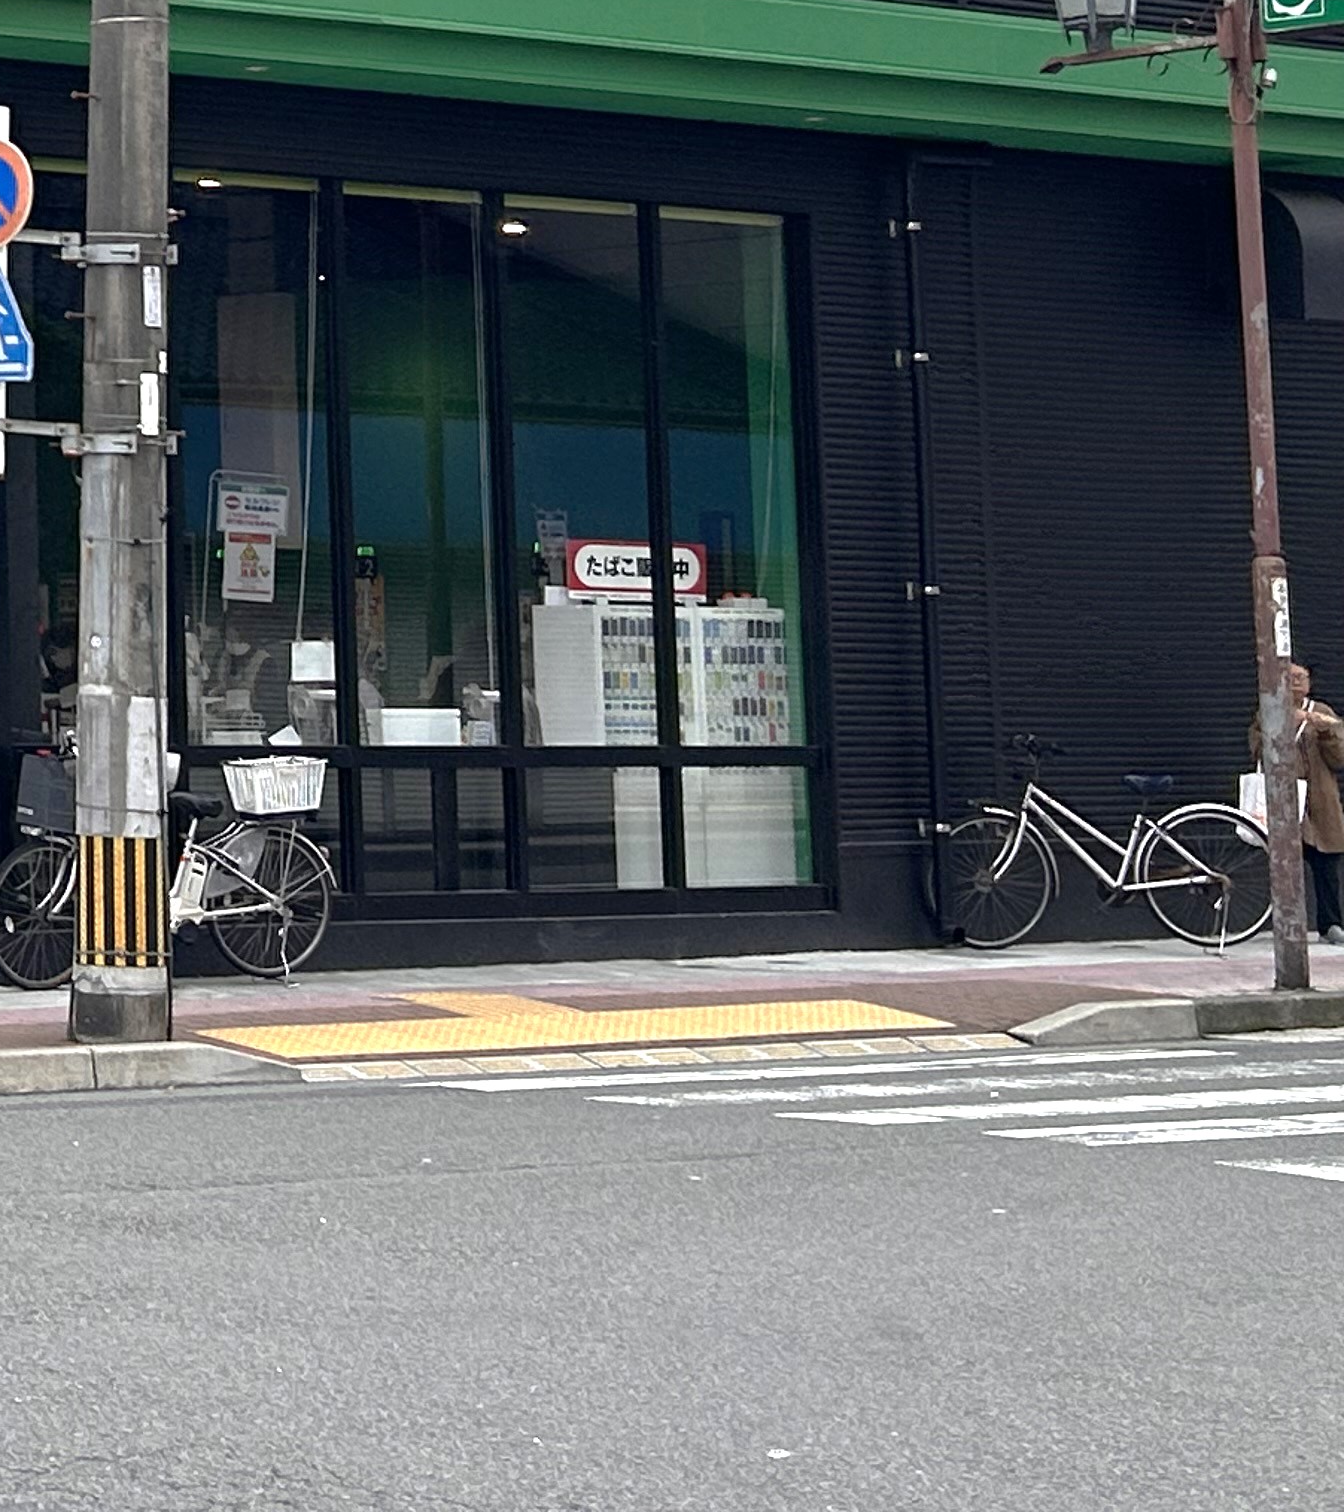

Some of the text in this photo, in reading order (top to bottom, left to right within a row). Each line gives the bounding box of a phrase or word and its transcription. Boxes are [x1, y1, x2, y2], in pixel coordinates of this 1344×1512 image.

[586, 554, 690, 581] たばこ販中
